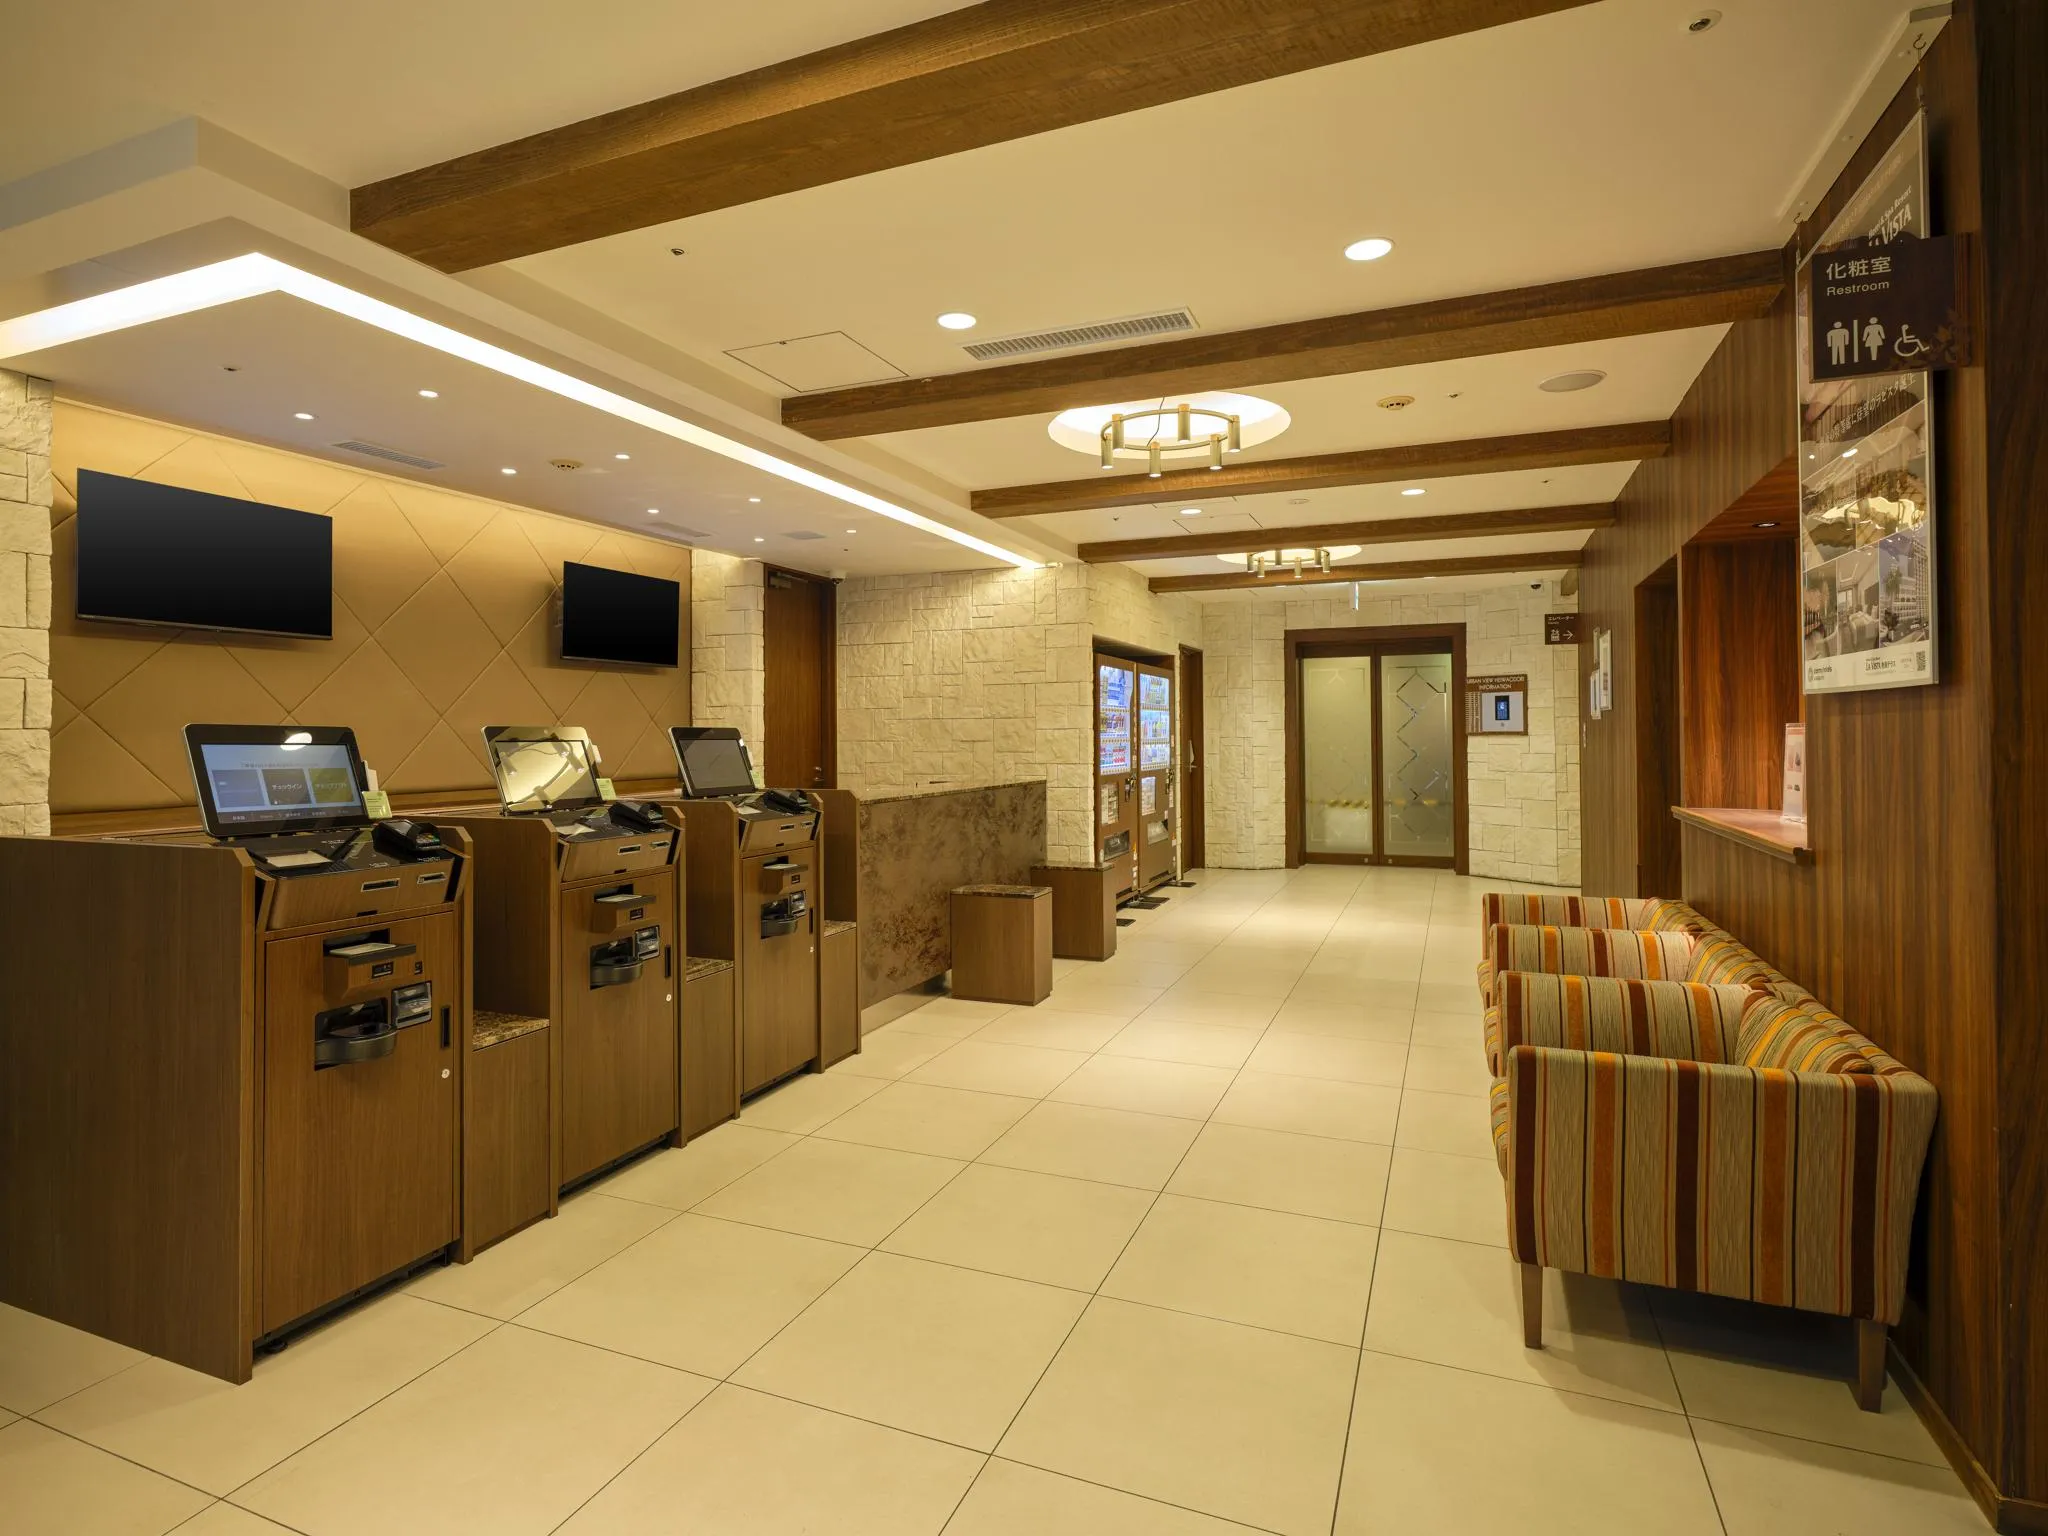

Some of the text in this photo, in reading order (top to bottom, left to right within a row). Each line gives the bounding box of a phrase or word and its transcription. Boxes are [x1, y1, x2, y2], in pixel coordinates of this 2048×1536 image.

[1881, 202, 1912, 245] VISTA
[1826, 256, 1892, 280] 化粧室
[1826, 281, 1890, 296] Restroom
